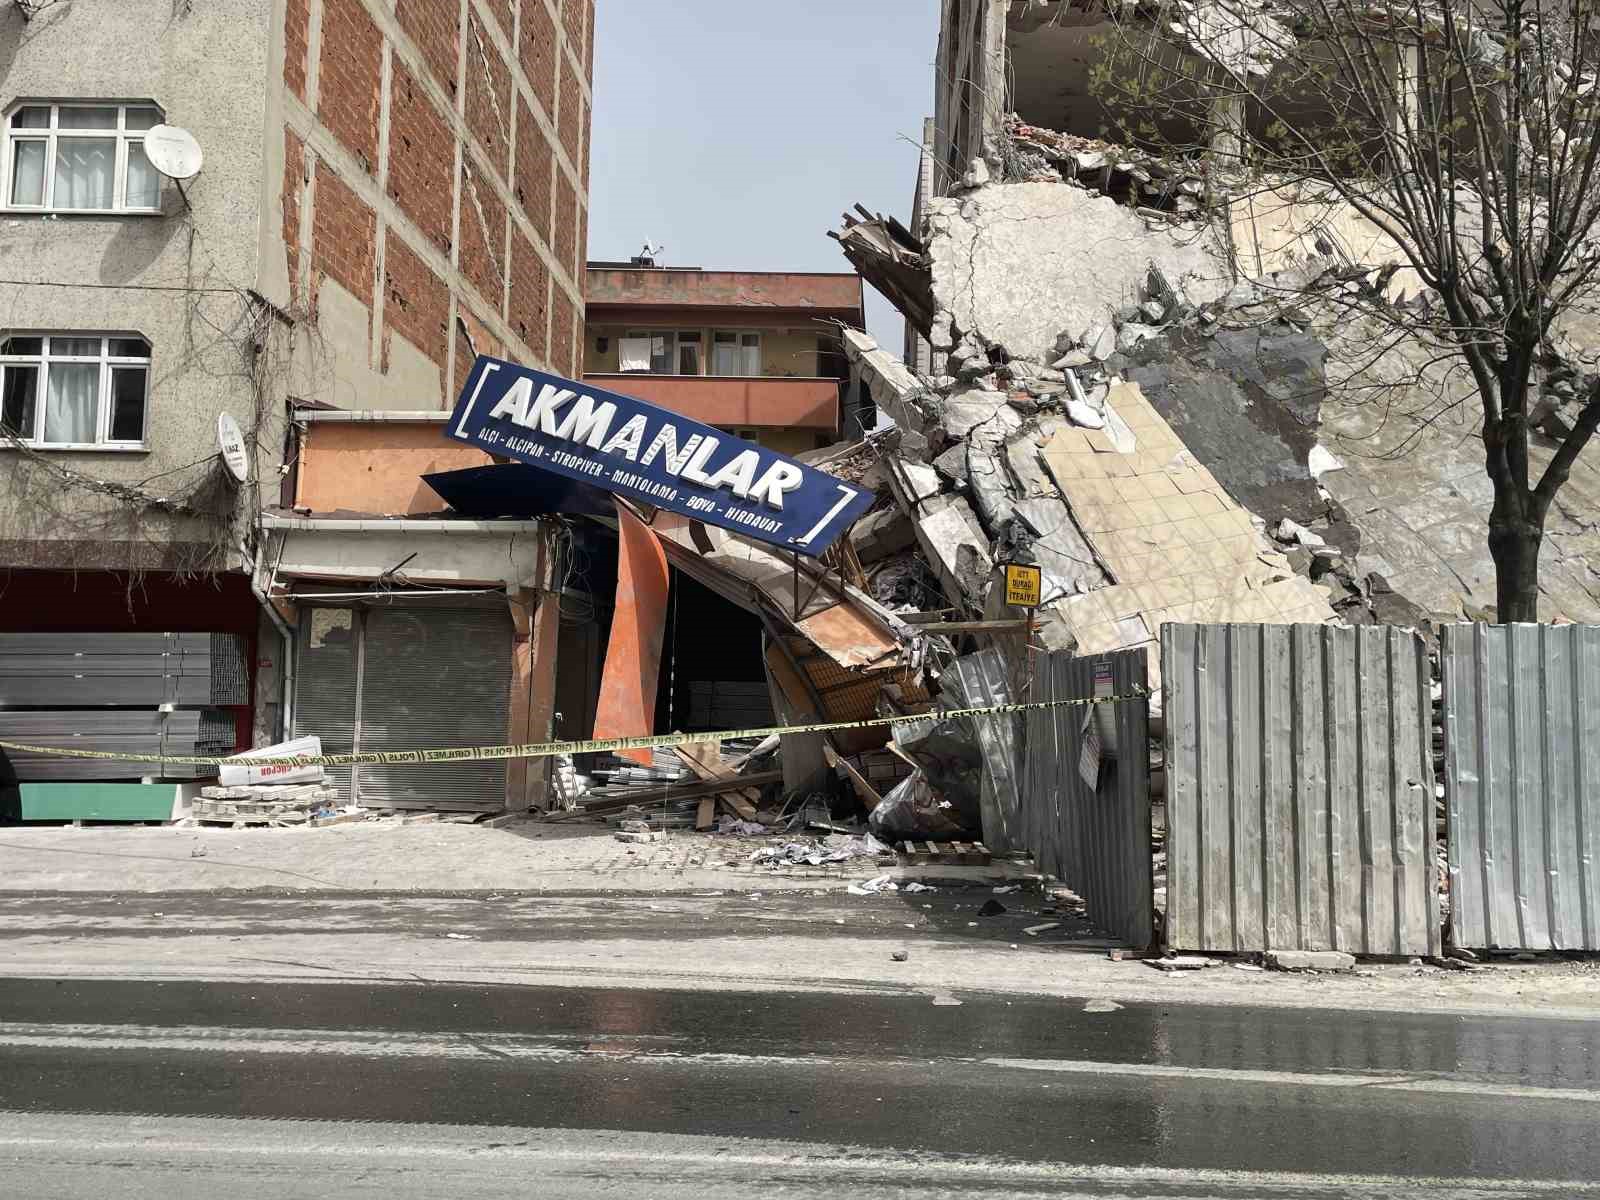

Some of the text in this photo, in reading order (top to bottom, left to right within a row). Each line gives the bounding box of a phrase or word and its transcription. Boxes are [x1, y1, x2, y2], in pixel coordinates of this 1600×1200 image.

[489, 376, 803, 511] AKMANLAR
[611, 470, 677, 501] MANTOLAMA
[686, 495, 714, 513] BOYA
[724, 506, 783, 534] HIRDAVAT
